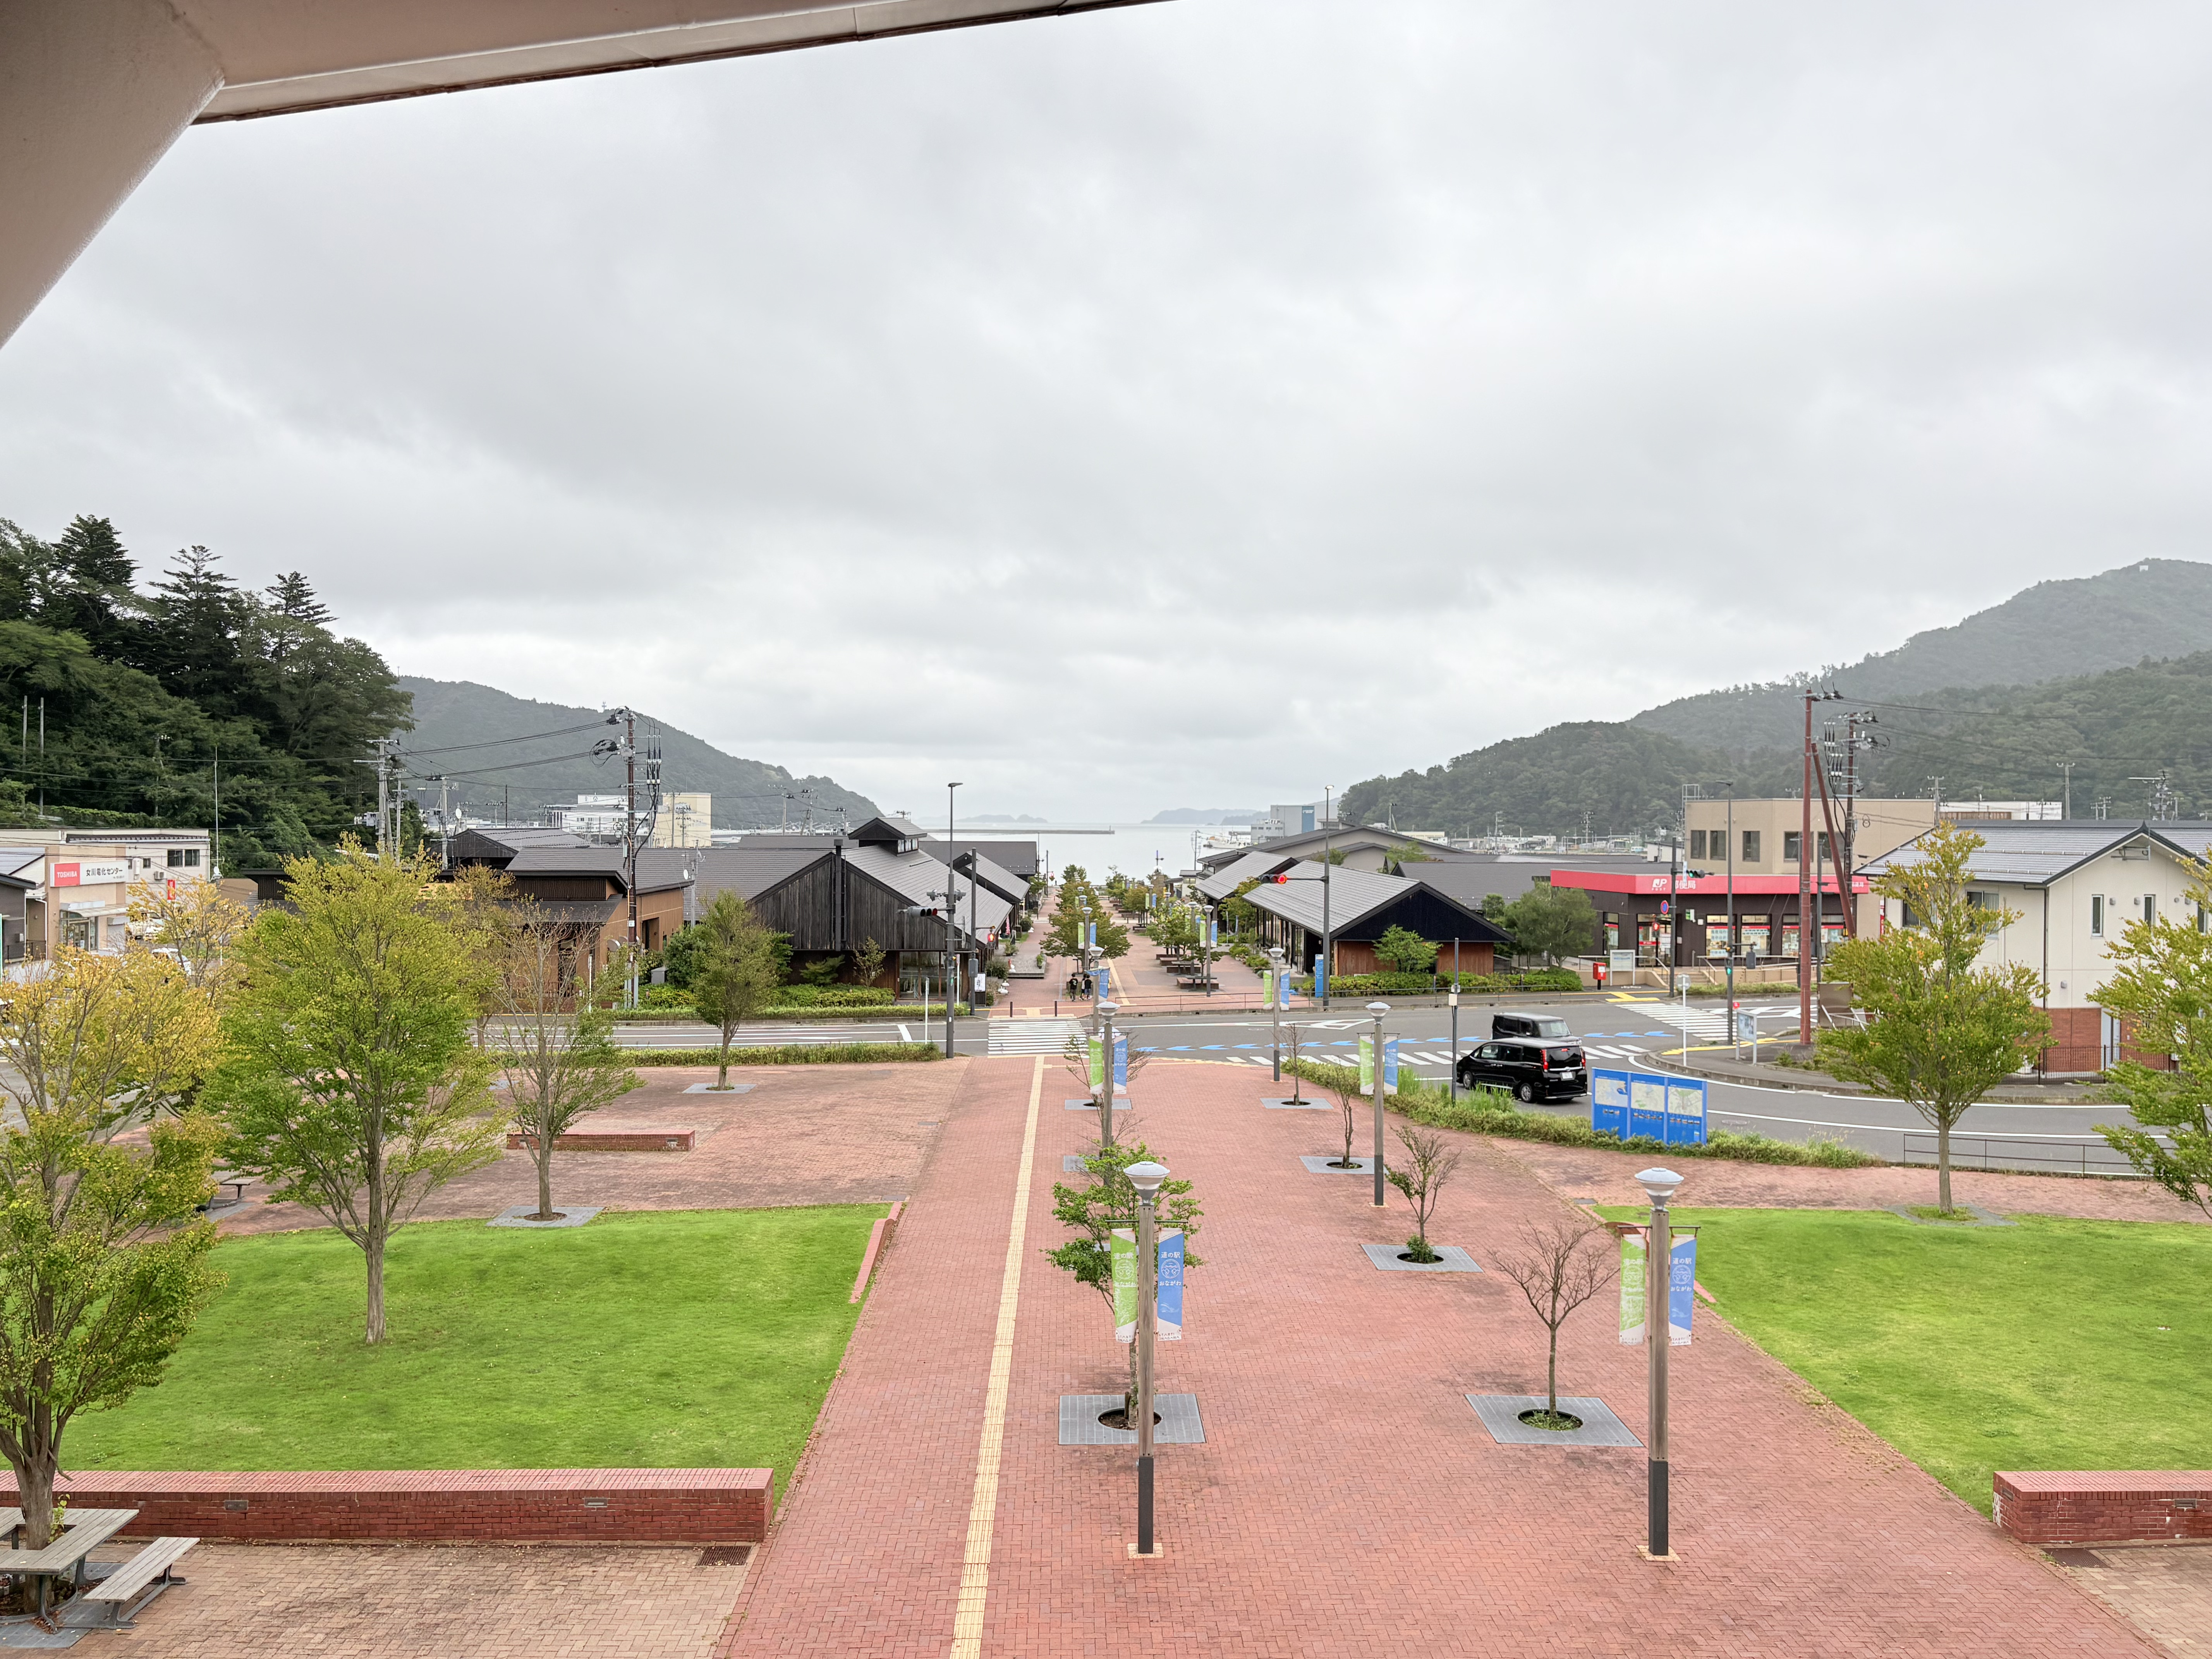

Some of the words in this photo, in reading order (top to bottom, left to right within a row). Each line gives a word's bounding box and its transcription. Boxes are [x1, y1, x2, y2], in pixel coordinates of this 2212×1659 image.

[86, 867, 123, 876] 女川電化センター
